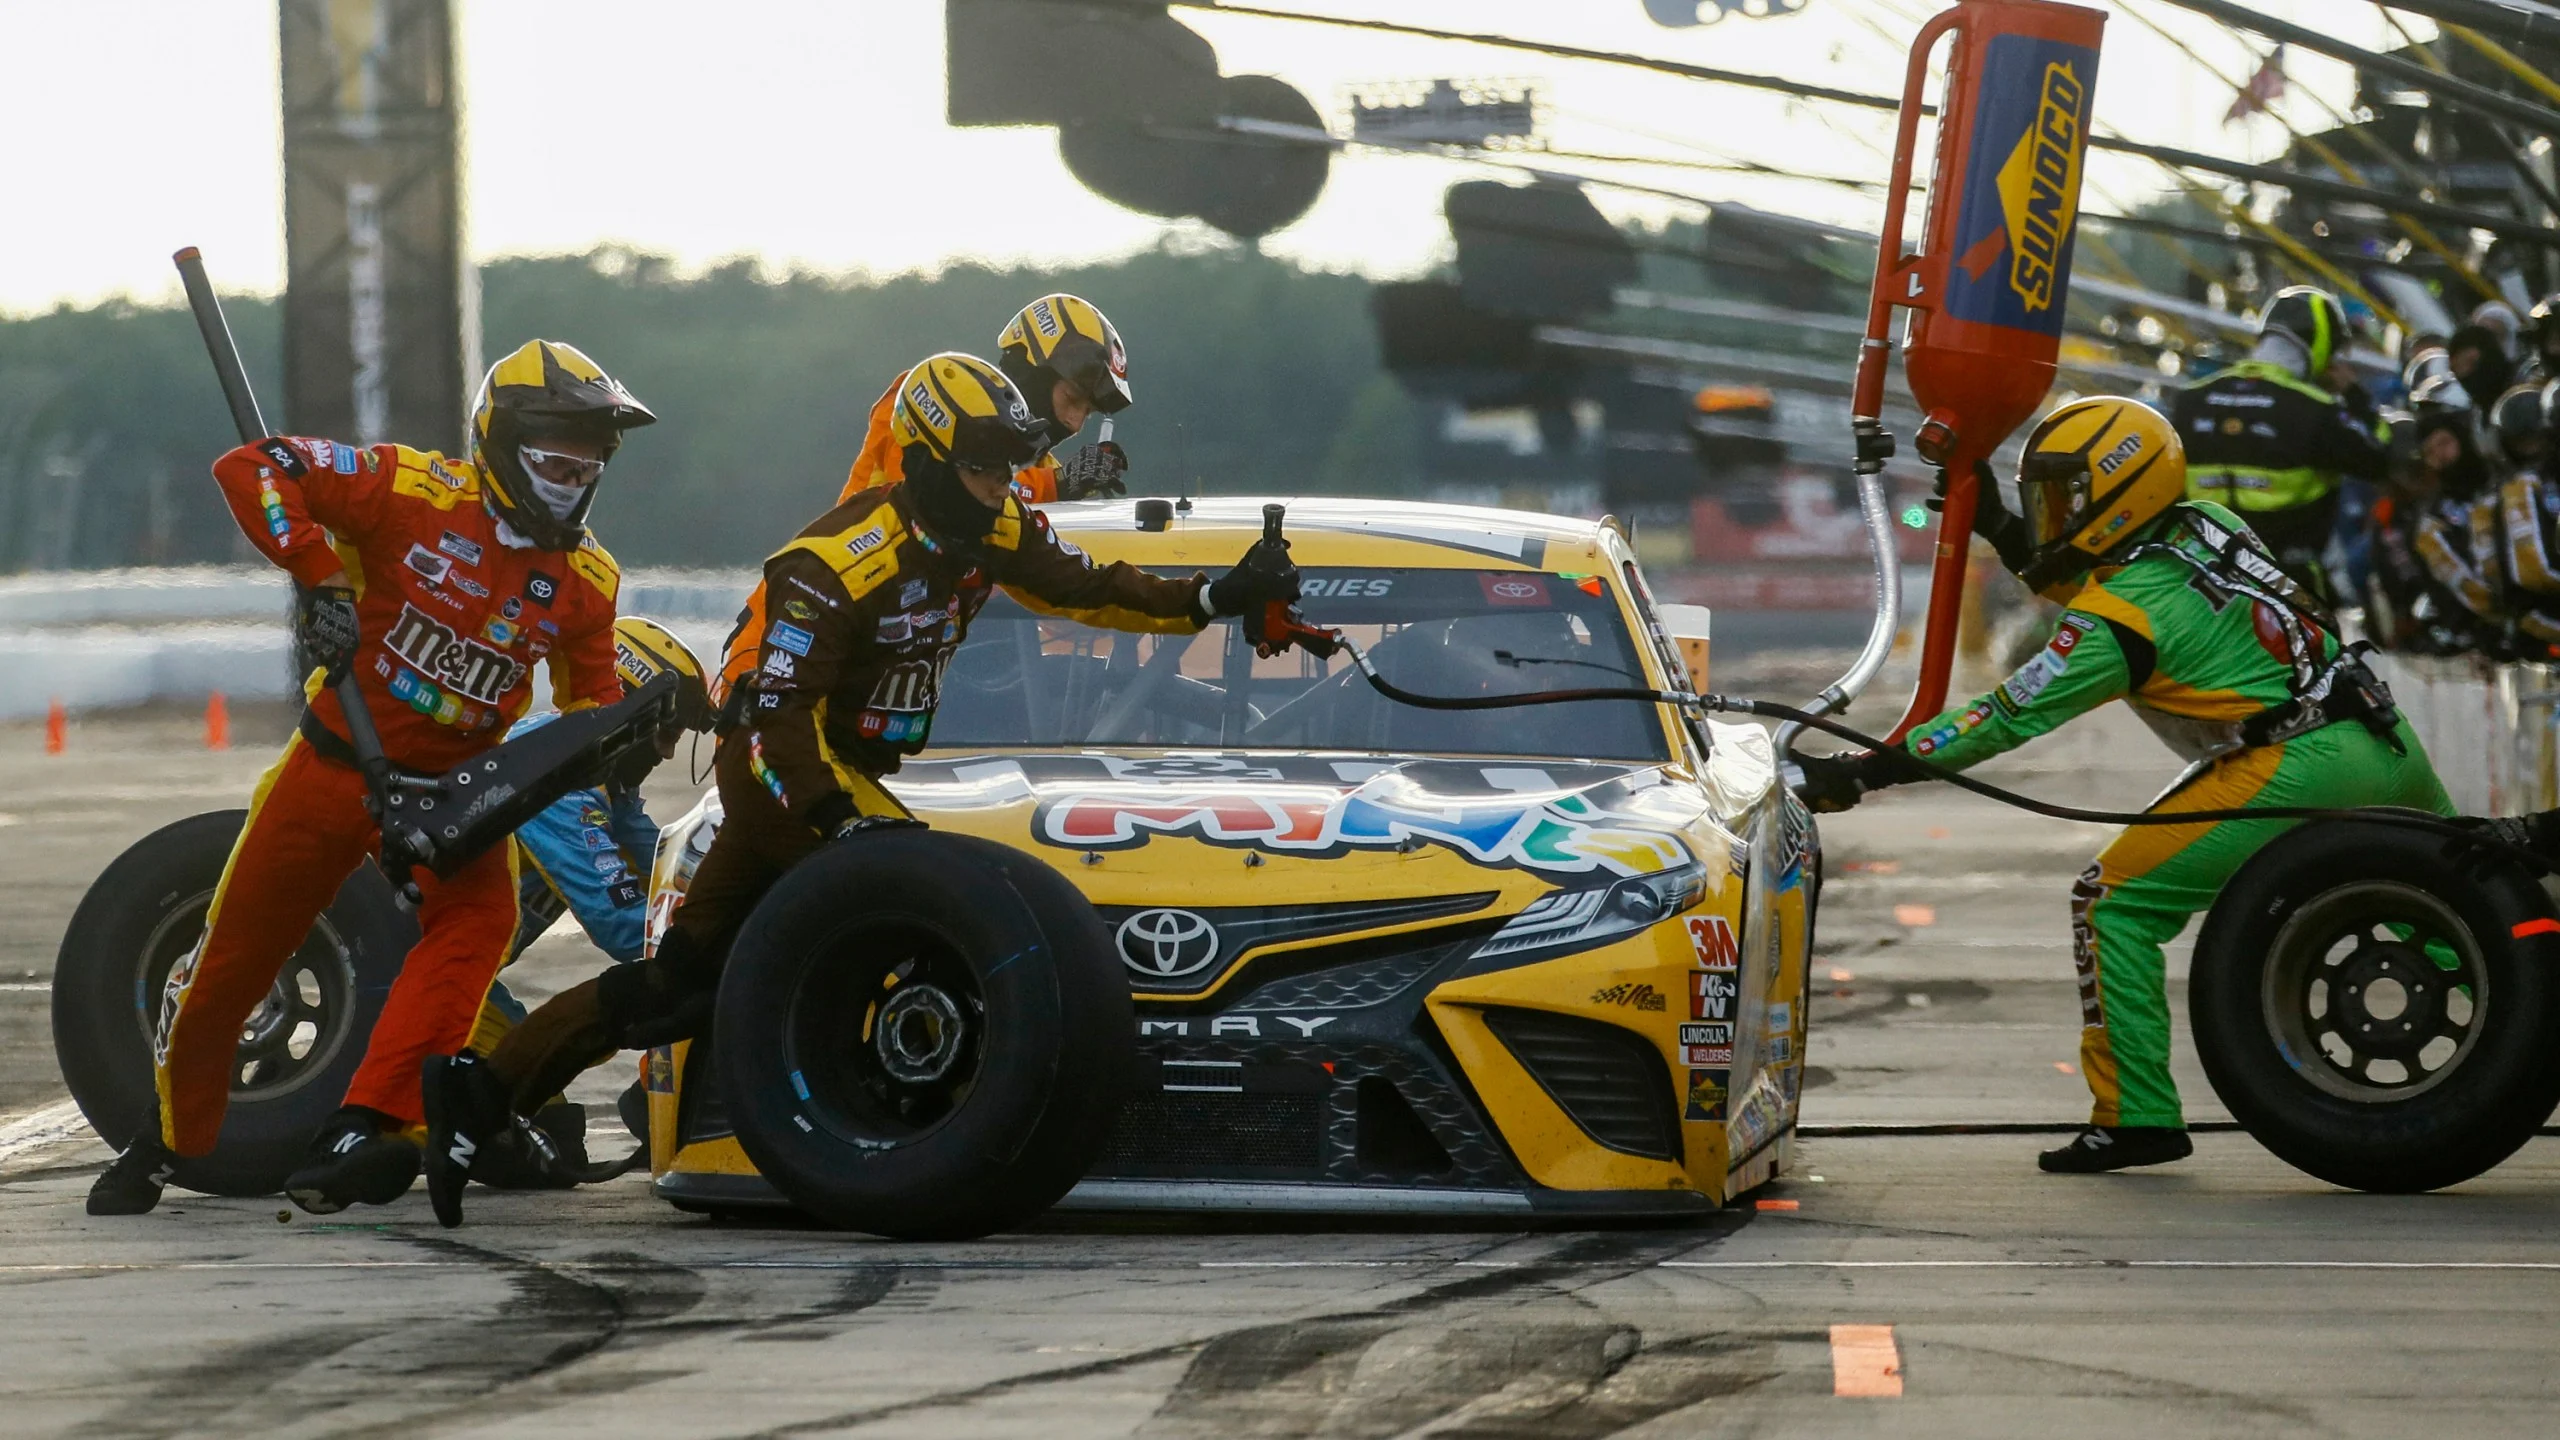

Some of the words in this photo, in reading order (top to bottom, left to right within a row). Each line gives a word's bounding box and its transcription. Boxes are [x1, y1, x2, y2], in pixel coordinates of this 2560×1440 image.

[2012, 66, 2080, 305] SUNOCO
[1299, 579, 1392, 597] RIES
[758, 694, 779, 708] PC2
[1690, 918, 1738, 967] 3M
[1141, 1016, 1338, 1038] MRY
[1682, 1027, 1724, 1044] LINCOLN
[1693, 1049, 1732, 1062] WELDERS
